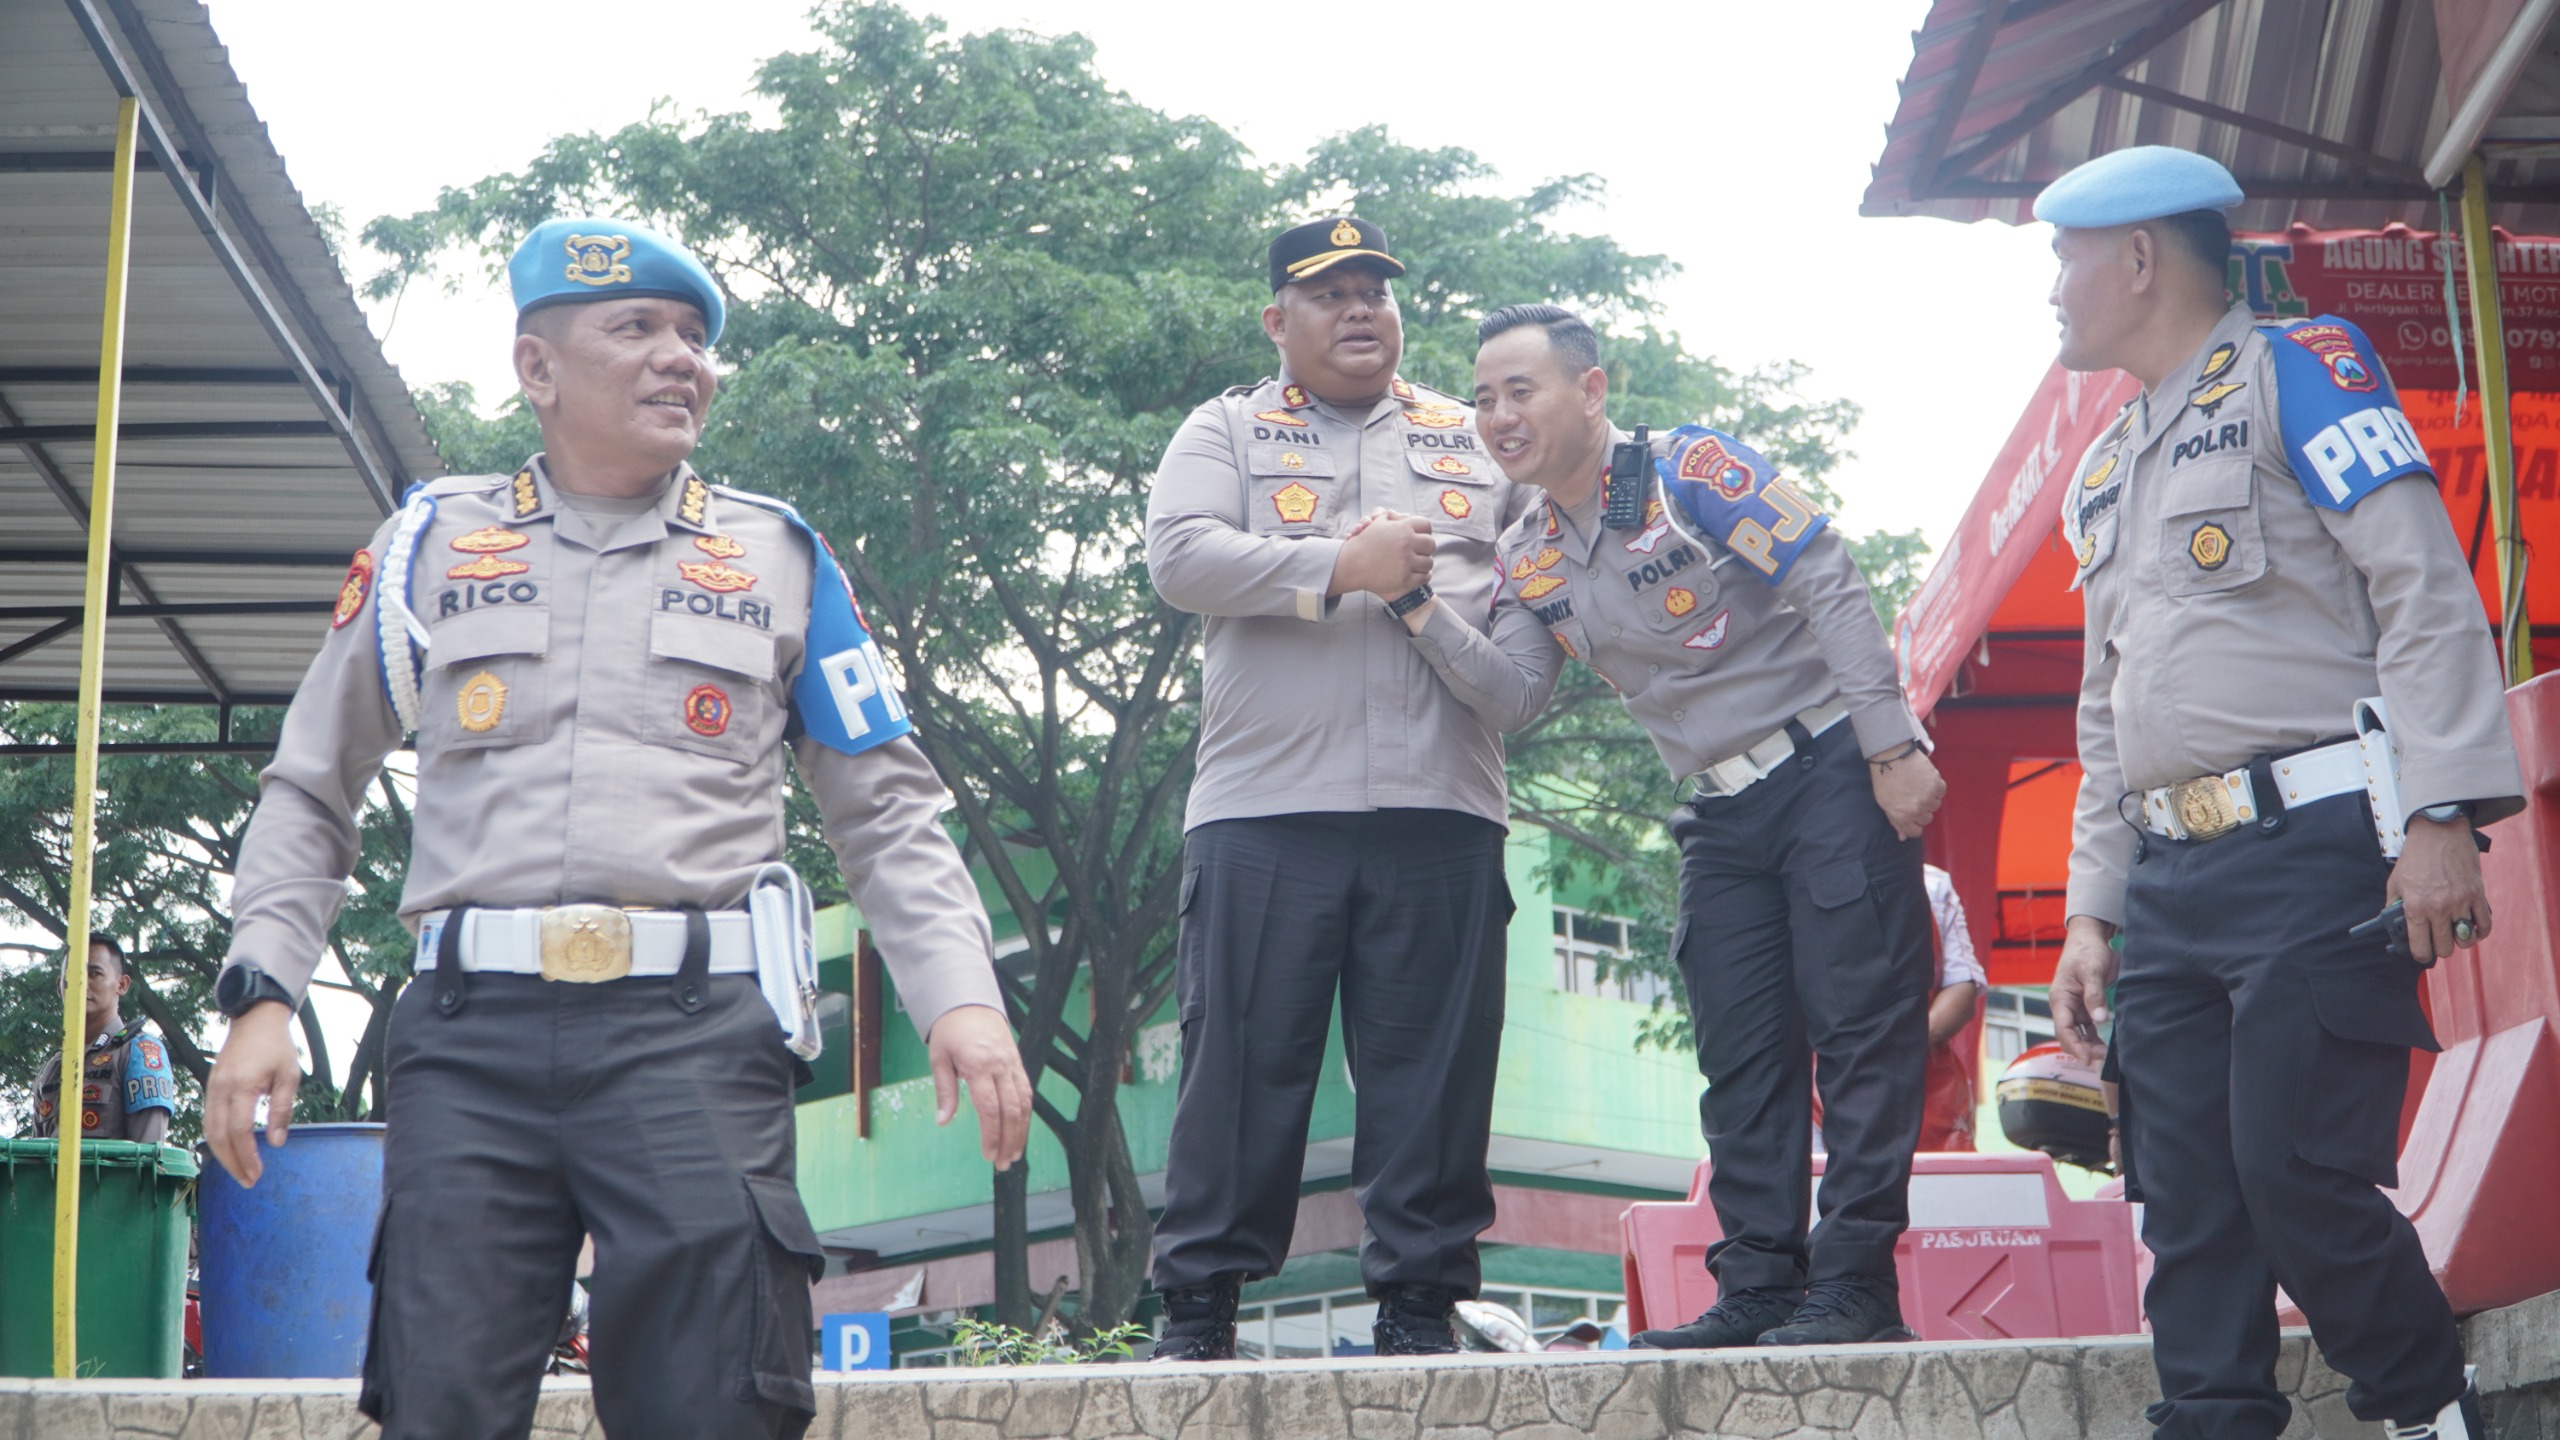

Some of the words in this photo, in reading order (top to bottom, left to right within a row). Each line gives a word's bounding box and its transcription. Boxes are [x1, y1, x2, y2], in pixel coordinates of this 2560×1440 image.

[2322, 238, 2425, 271] AGUNG
[2346, 283, 2434, 300] DEALER
[2513, 285, 2560, 303] MOT
[2506, 329, 2560, 350] 079
[1253, 426, 1320, 446] DANI
[1407, 433, 1475, 450] POLRI
[2172, 420, 2248, 468] POLRI
[1685, 441, 1714, 473] POLDA
[1627, 544, 1695, 592] POLRI
[439, 581, 538, 617] RICO
[661, 588, 771, 628] POLRI
[1921, 1230, 2042, 1249] PASURUAN
[840, 1324, 871, 1372] P
